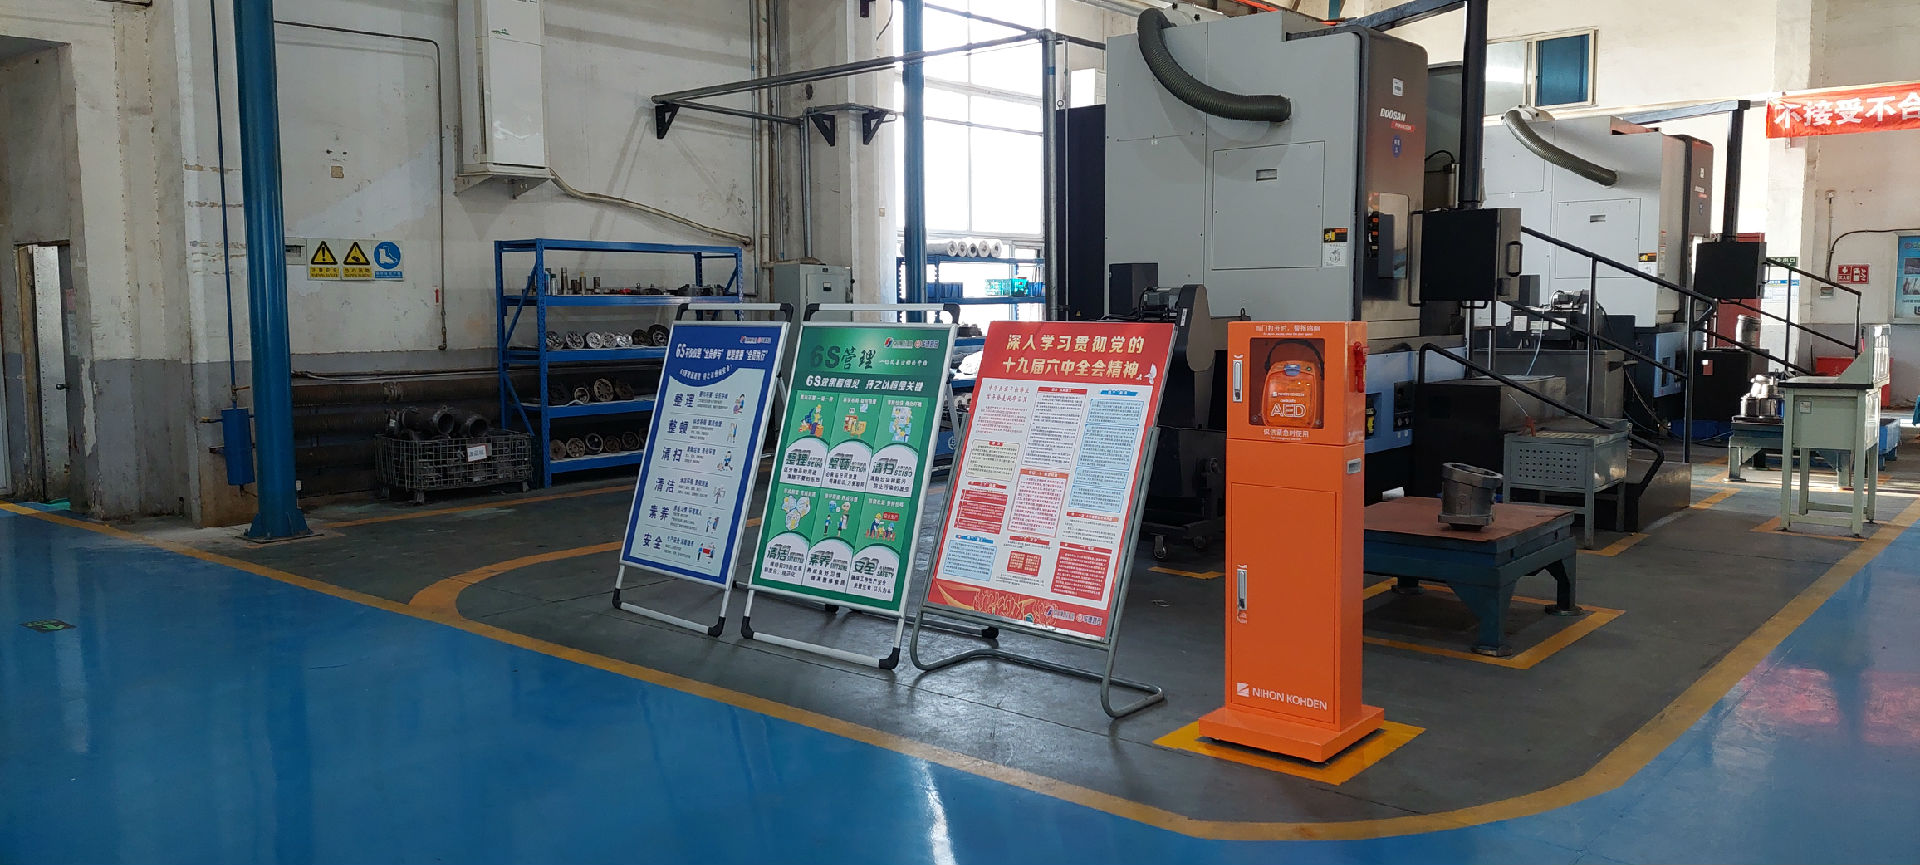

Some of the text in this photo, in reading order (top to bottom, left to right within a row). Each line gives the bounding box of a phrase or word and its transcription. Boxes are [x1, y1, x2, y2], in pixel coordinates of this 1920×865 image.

[1380, 108, 1406, 122] DOOSAN
[1774, 92, 1920, 129] 不接受不合
[1006, 334, 1145, 354] 深入学习贯彻党的
[809, 345, 877, 370] 6S管理
[1003, 357, 1140, 379] 十九届六中全会精神
[673, 393, 695, 408] 整理
[1271, 404, 1306, 418] AED
[667, 419, 689, 434] 整顿
[661, 446, 683, 462] 清扫
[785, 452, 809, 467] 整理
[828, 457, 851, 471] 整顿
[871, 461, 895, 475] 清扫
[654, 477, 676, 493] 清洁
[648, 504, 670, 520] 素养
[642, 532, 663, 550] 安全
[766, 546, 789, 561] 清洁
[809, 554, 831, 567] 素养
[853, 560, 877, 576] 安全
[1252, 687, 1328, 711] NIHON KOHDEN
